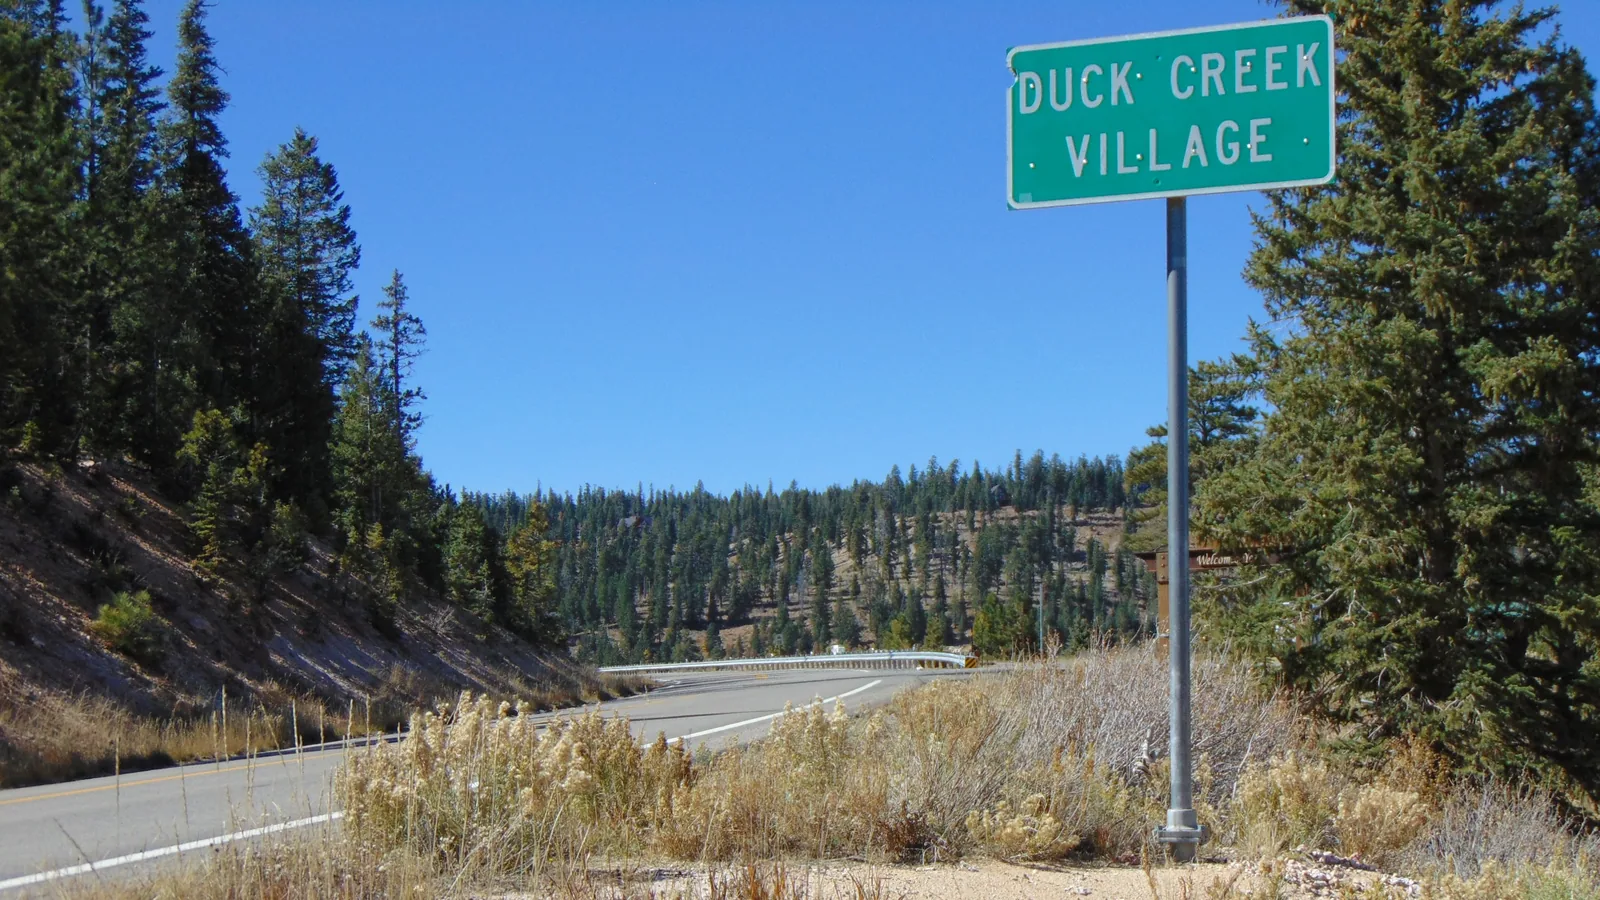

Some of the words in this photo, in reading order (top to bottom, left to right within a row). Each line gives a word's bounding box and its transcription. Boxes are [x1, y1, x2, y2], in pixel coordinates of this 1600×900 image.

[1019, 61, 1134, 114] DUCK
[1170, 42, 1321, 100] CREEK
[1065, 117, 1273, 178] VILLAGE
